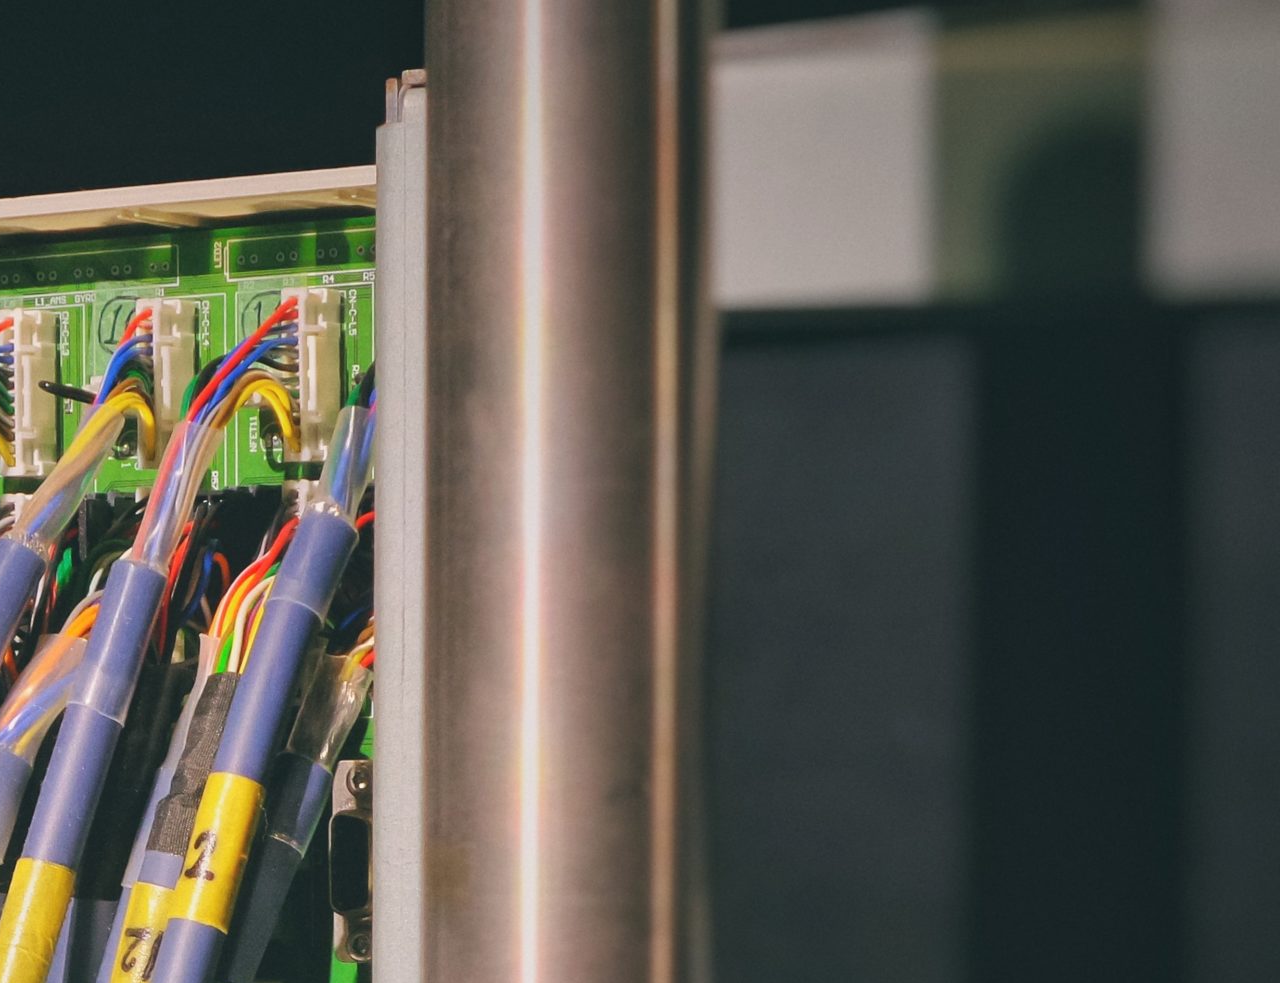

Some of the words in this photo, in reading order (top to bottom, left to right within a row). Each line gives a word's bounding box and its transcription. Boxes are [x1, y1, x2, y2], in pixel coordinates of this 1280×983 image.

[213, 241, 222, 268] LED2
[323, 274, 335, 284] R4
[363, 271, 376, 281] R5
[201, 300, 210, 346] CN-C-L4
[348, 289, 358, 336] CN-C-L5
[249, 416, 258, 453] NFET11
[184, 830, 217, 882] 2
